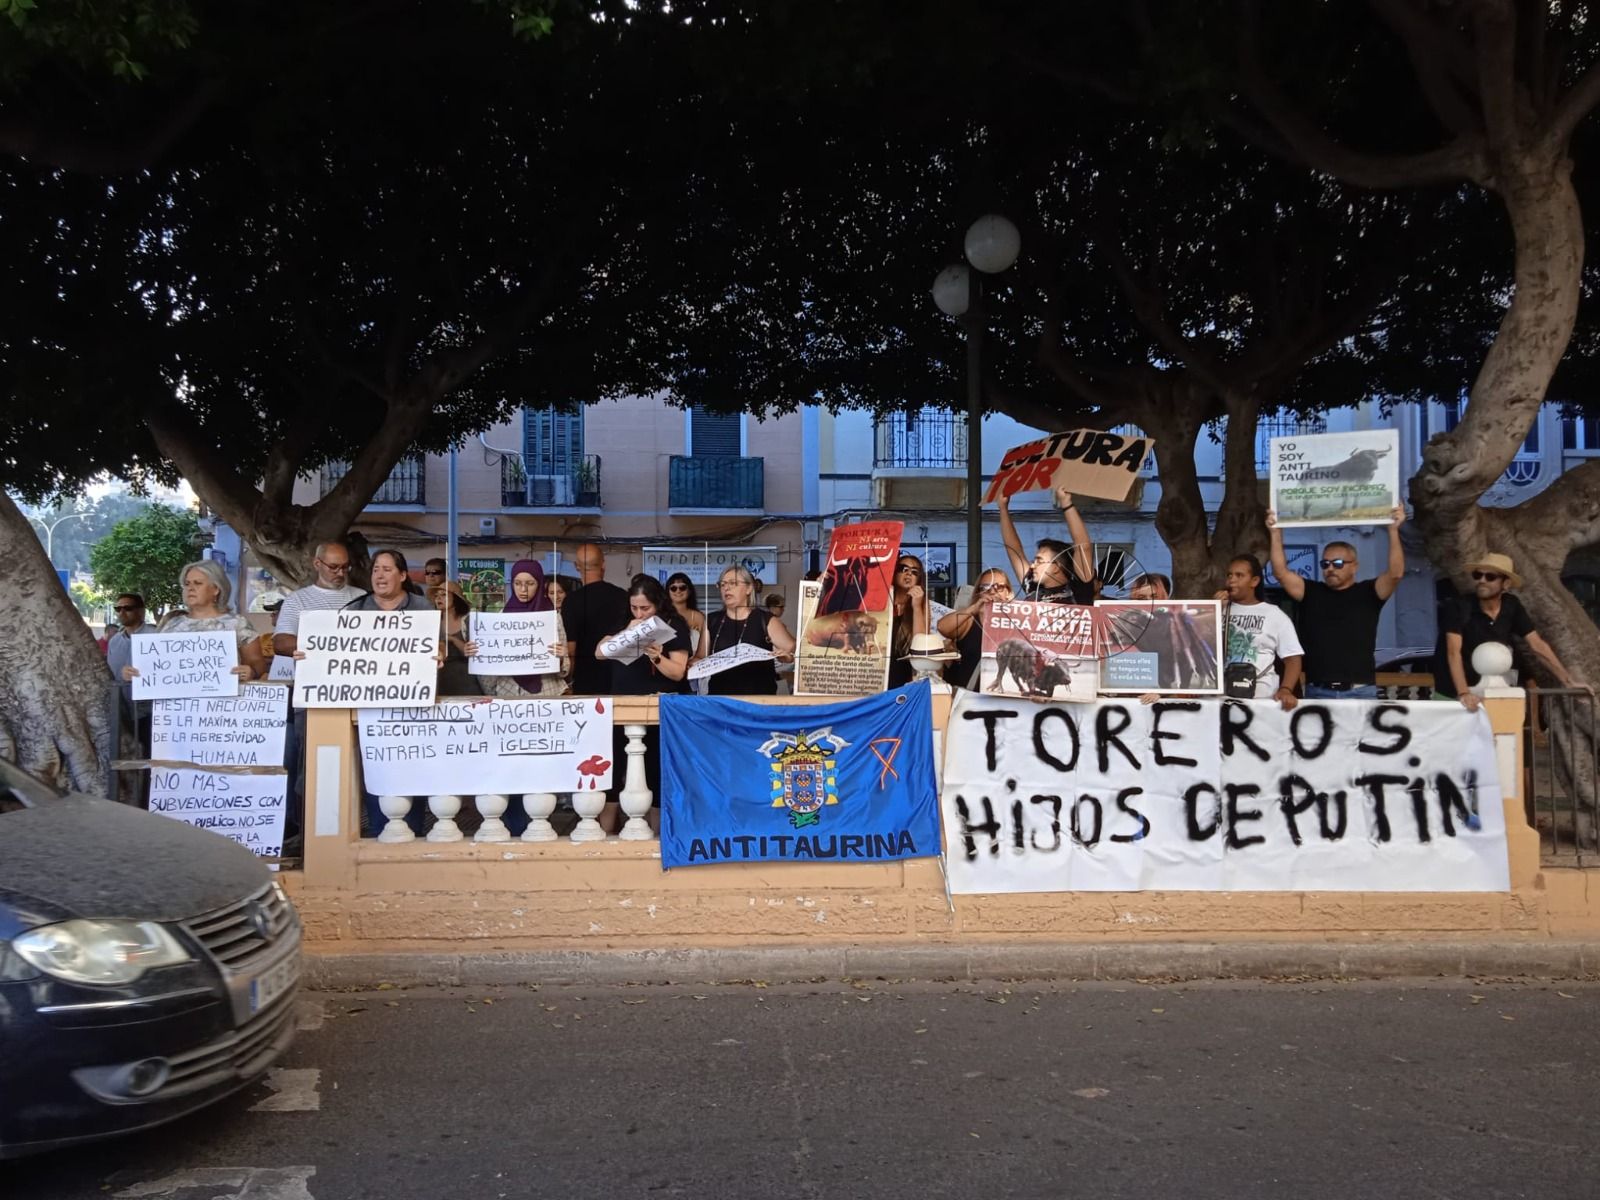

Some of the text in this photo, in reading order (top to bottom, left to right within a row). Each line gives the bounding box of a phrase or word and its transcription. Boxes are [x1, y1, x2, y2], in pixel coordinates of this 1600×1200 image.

[1278, 443, 1297, 452] YO
[1278, 453, 1304, 462] SOY
[1278, 462, 1312, 472] ANTI
[987, 457, 1062, 503] TOR
[1278, 471, 1340, 482] TAURINO
[859, 536, 870, 544] NI
[846, 543, 858, 552] NI
[992, 602, 1092, 620] ESTO NUNCA
[337, 614, 362, 630] NO
[473, 620, 545, 632] LA CRUELDAD
[990, 616, 1092, 636] SERÁ ARTE
[140, 641, 160, 656] LA
[305, 635, 434, 654] SUBVENCIONES
[487, 638, 500, 649] LA
[503, 637, 545, 648] FUERZA
[153, 656, 226, 671] NO ES ARTE
[327, 658, 410, 676] PARA LA
[162, 670, 221, 686] CULTURA
[243, 685, 285, 700] AMADA
[302, 680, 430, 704] TAUROMAQUÍA
[153, 699, 200, 712] FIESTA
[561, 702, 585, 715] POR
[153, 715, 172, 726] ES
[177, 715, 193, 727] LA
[153, 732, 168, 743] DE
[172, 732, 186, 743] LA
[366, 724, 438, 737] EJECUTAR
[448, 725, 457, 736] A
[465, 723, 484, 735] UN
[574, 719, 588, 742] Y
[446, 743, 464, 755] EN
[468, 741, 489, 754] LA
[191, 749, 258, 765] HUMANA
[155, 772, 231, 792] NO MAS
[259, 794, 284, 808] CON
[238, 816, 255, 828] NO
[255, 814, 276, 826] SE
[246, 832, 260, 842] LA
[688, 829, 917, 862] ANTITAURINA
